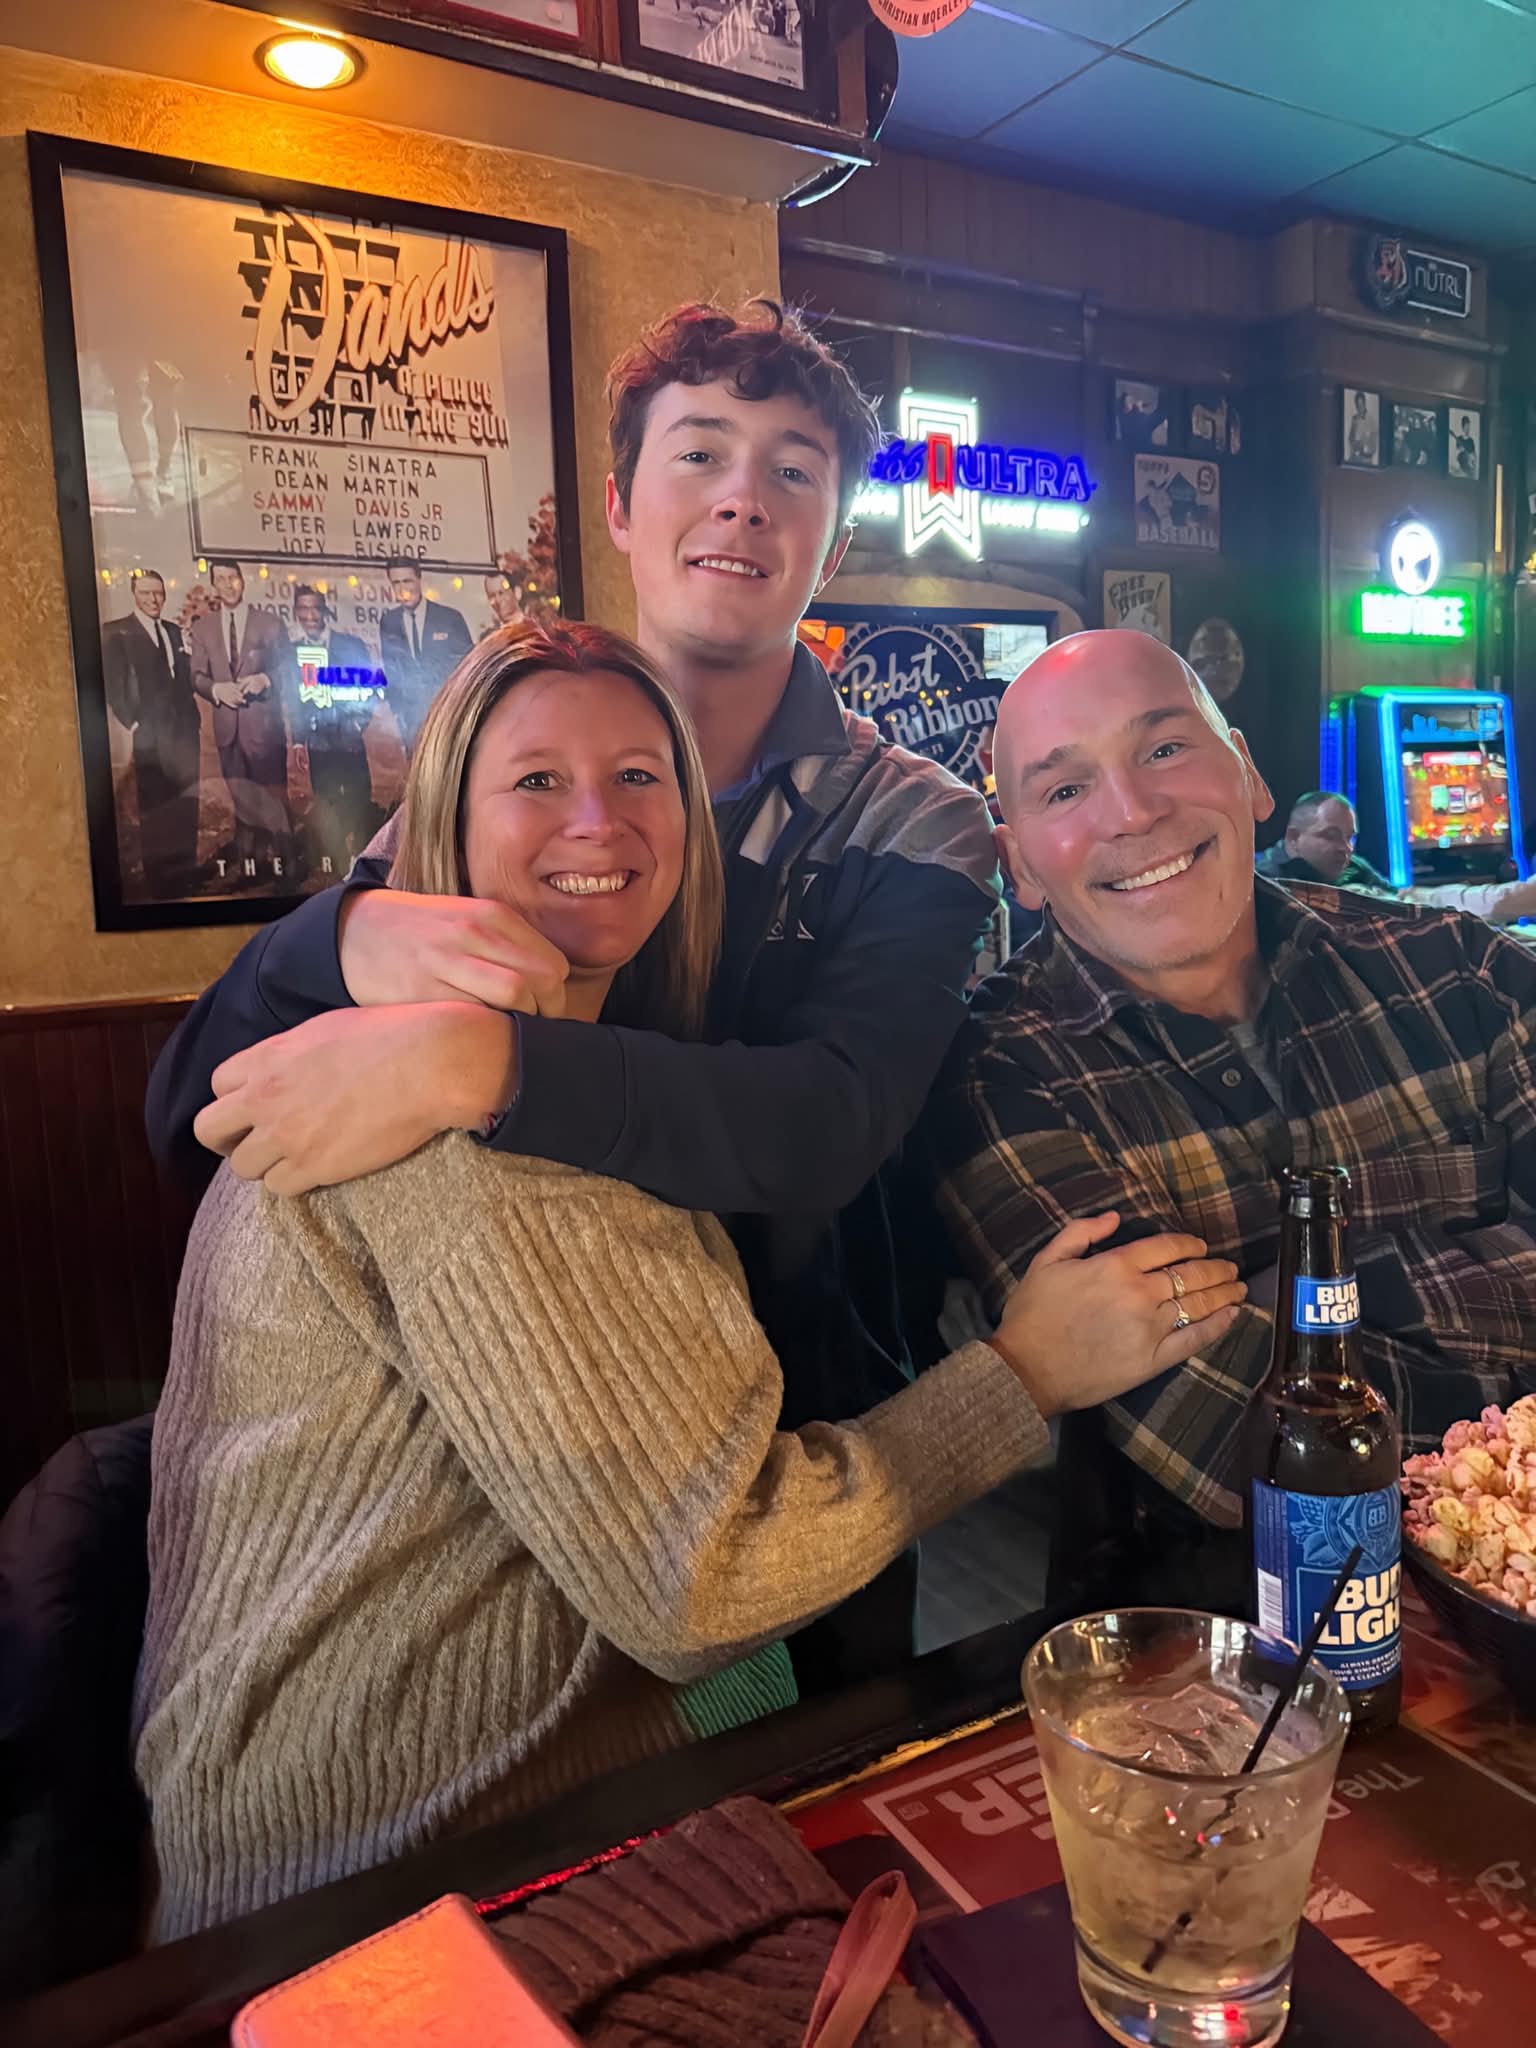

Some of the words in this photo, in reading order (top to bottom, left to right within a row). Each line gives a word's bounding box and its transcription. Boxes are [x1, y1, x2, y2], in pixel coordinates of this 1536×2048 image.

[921, 0, 963, 26] MOERLE
[425, 372, 495, 410] PLACE
[250, 444, 319, 469] FRANK
[347, 453, 437, 479] SINATRA
[957, 445, 1091, 502] ULTRA
[275, 470, 329, 492] DEAN
[344, 476, 420, 499] MARTIN
[253, 491, 327, 514] SAMMY
[355, 498, 410, 520] DAVIS
[421, 502, 444, 521] JR
[261, 514, 326, 536] PETER
[352, 519, 442, 542] LAWFORD
[1137, 522, 1217, 548] BASEBALL
[837, 642, 941, 710] Pabst
[885, 692, 1000, 748] Ribbon
[216, 856, 284, 877] THE
[1317, 1280, 1358, 1305] BUD
[1305, 1298, 1359, 1324] LIGH
[1314, 1598, 1401, 1645] LIGH
[936, 1756, 1054, 1835] ER
[1334, 1761, 1425, 1799] The
